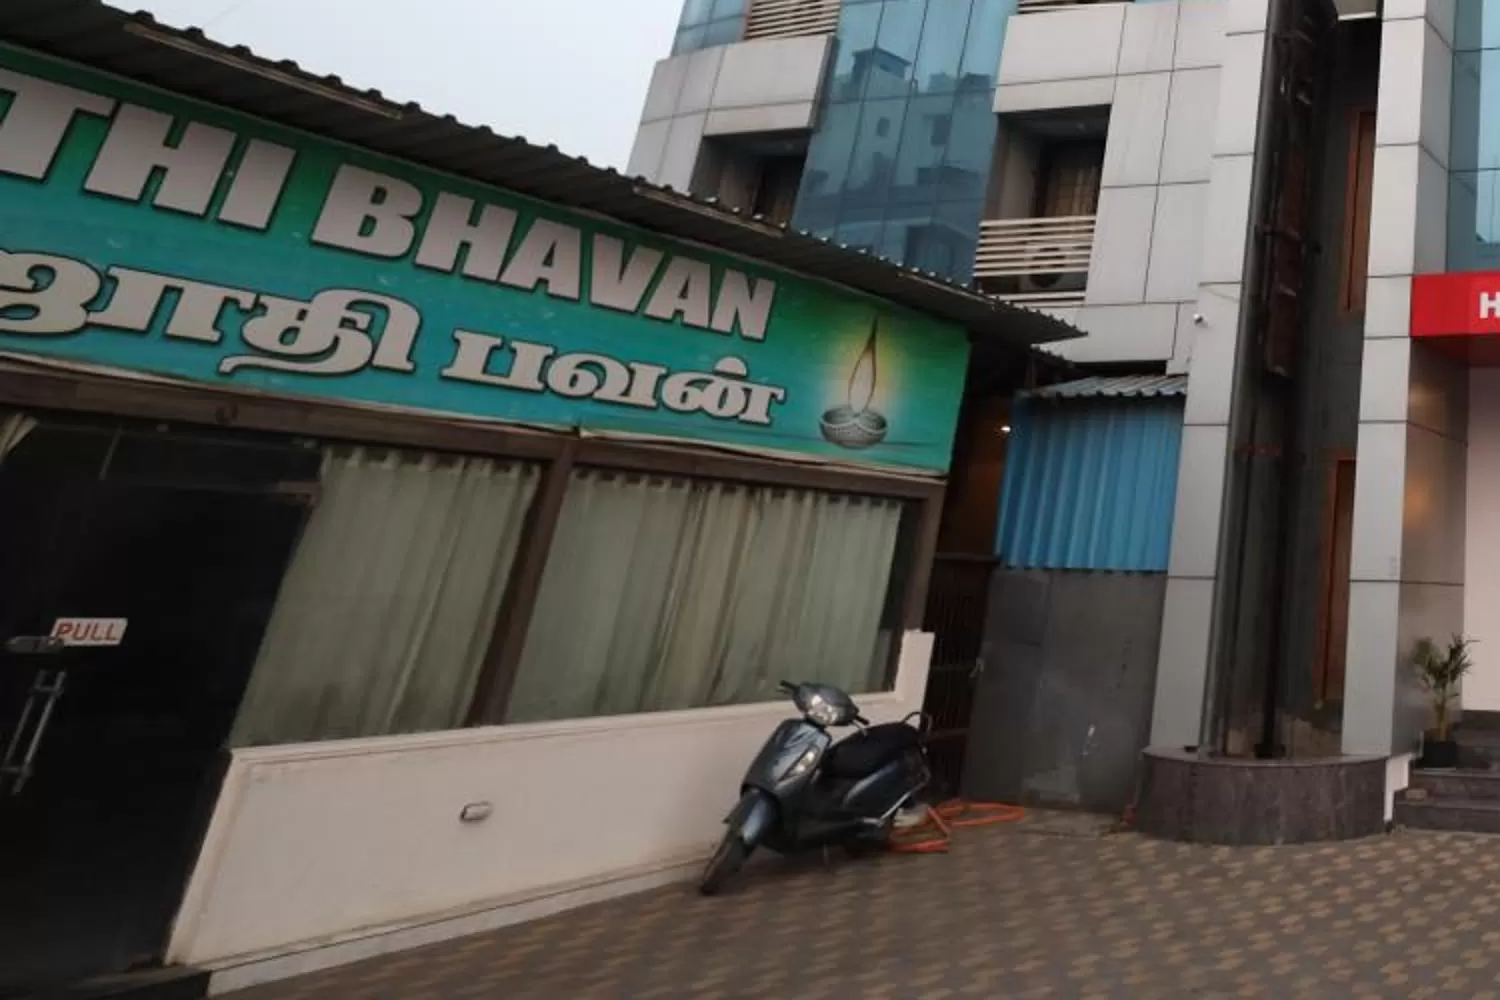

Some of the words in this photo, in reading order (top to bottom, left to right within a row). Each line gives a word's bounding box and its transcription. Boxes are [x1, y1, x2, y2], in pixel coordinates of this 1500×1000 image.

[311, 163, 777, 340] BHAVAN
[441, 328, 786, 424] பவன்
[55, 622, 118, 642] PULL
